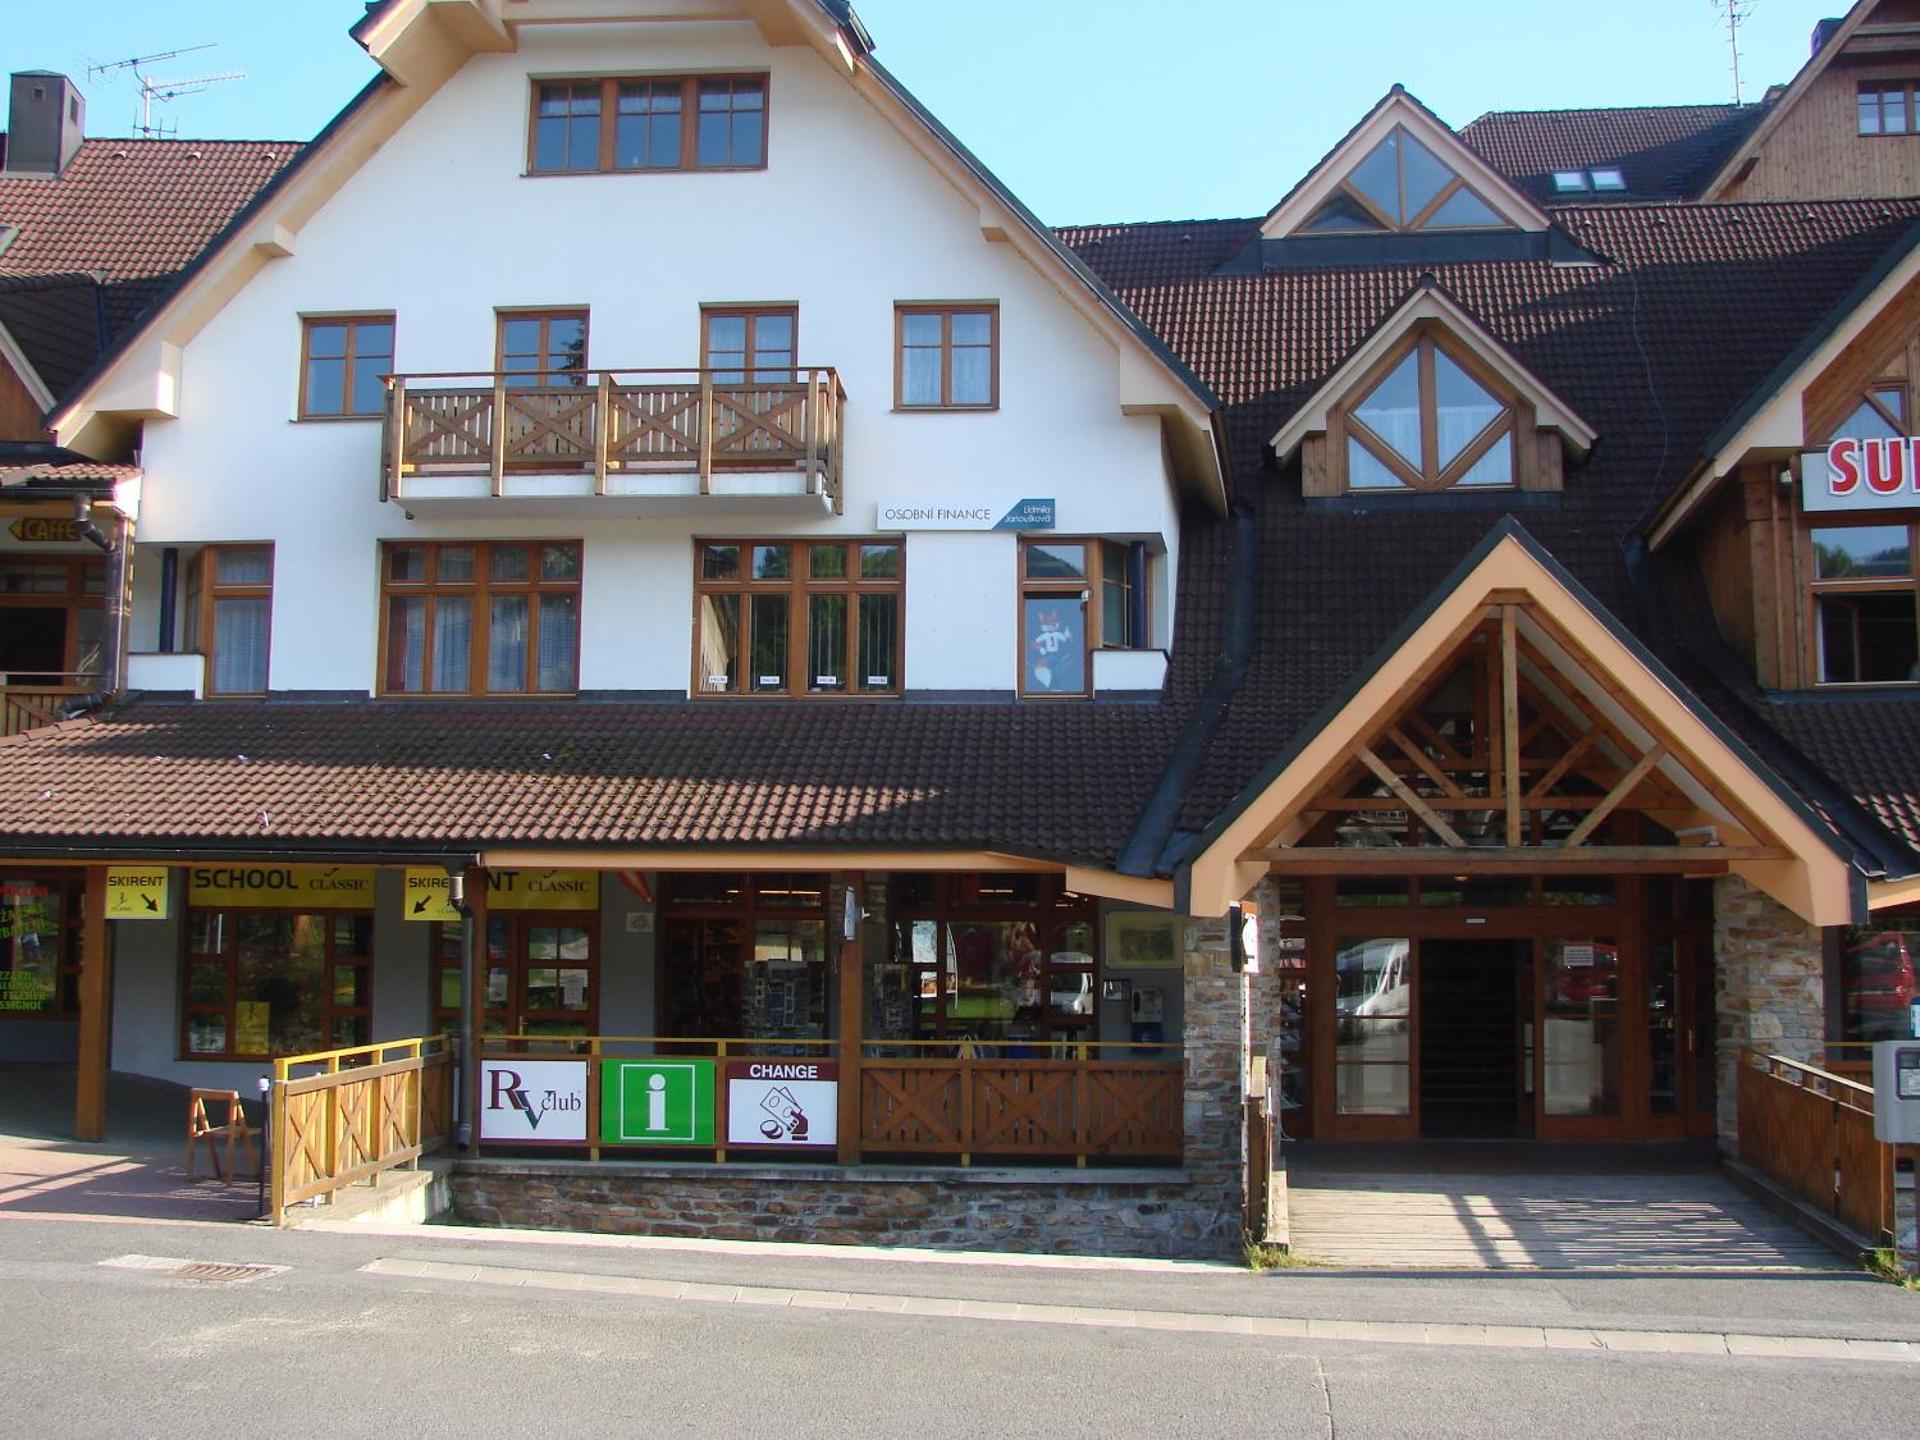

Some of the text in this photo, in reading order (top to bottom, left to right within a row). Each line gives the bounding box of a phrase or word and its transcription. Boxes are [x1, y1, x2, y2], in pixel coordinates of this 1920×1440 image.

[885, 506, 991, 520] OSOBNÍ FINANCE
[108, 876, 165, 887] SKIRENT
[194, 868, 369, 891] SCHOOL CLASSIC
[527, 879, 590, 892] CLASSIC
[749, 1064, 819, 1079] CHANGE
